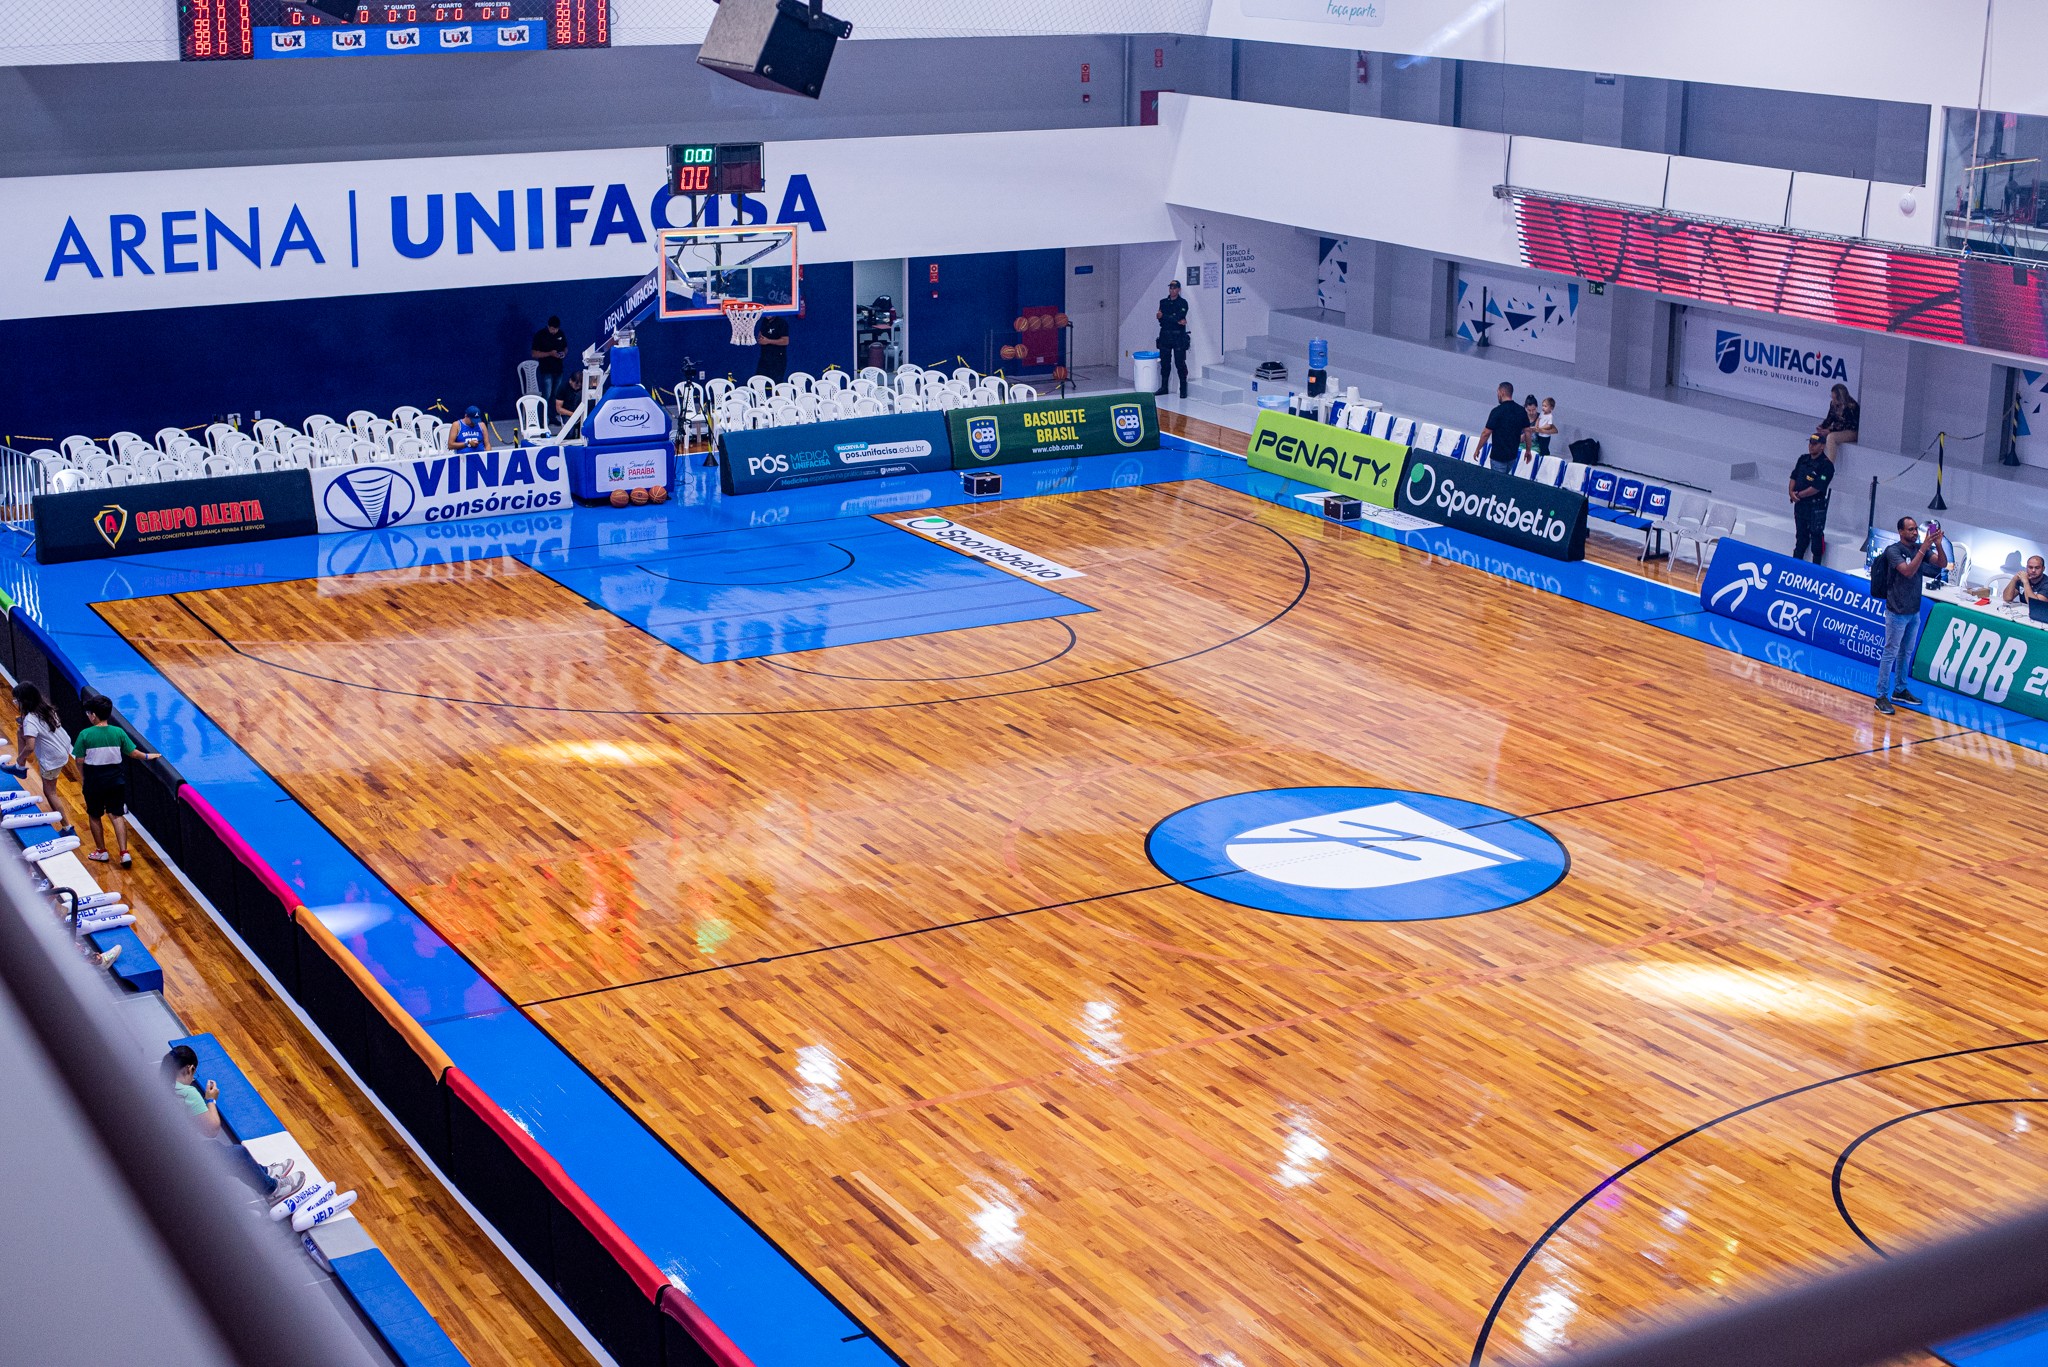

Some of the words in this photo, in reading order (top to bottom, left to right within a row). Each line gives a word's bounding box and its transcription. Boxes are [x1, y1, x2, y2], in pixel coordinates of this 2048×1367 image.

[1348, 3, 1377, 21] parte.
[680, 166, 710, 190] 00
[44, 203, 326, 282] ARENA
[391, 173, 827, 259] UNIFACISA
[604, 306, 625, 334] ARENA
[626, 276, 658, 314] UNIFACISA
[1743, 338, 1848, 383] UNIFACISA
[1743, 366, 1768, 376] CENTRO
[1770, 372, 1820, 388] UNIVERSITÁRIO
[614, 414, 645, 423] ROCHA
[1024, 409, 1087, 428] BASQUETE
[1036, 426, 1080, 444] BRASIL
[790, 450, 830, 462] MÉDICA
[845, 444, 925, 460] pos.unifacisa.edu.br
[1032, 443, 1084, 454] www.cbb.com.br
[1255, 430, 1391, 486] PENALTY
[412, 446, 560, 498] VINAC
[628, 467, 655, 476] PARAÍBA
[748, 453, 790, 476] PÓS
[792, 458, 831, 470] UNIFACISA
[782, 476, 809, 486] Medicina
[809, 473, 835, 485] esportiva
[136, 506, 198, 534] GRUPO
[201, 499, 264, 526] ALERTA
[424, 489, 562, 522] consórcios
[1436, 478, 1566, 542] Sportsbet.io
[162, 532, 186, 540] CONCEITO
[936, 529, 1062, 579] Sportsbet.io
[1778, 570, 1843, 601] FORMAÇÃO
[1844, 591, 1862, 608] DE
[1766, 600, 1812, 637] CBC
[1822, 616, 1858, 638] COMITÊ
[1840, 638, 1846, 646] DE
[1846, 640, 1882, 661] CLUBES
[1928, 616, 2028, 704] NBB
[2024, 666, 2048, 698] 2
[36, 840, 53, 850] HELP
[78, 896, 92, 906] ELP
[78, 908, 98, 918] HELP
[293, 1184, 322, 1204] UNIFACISA
[312, 1206, 334, 1226] HELP
